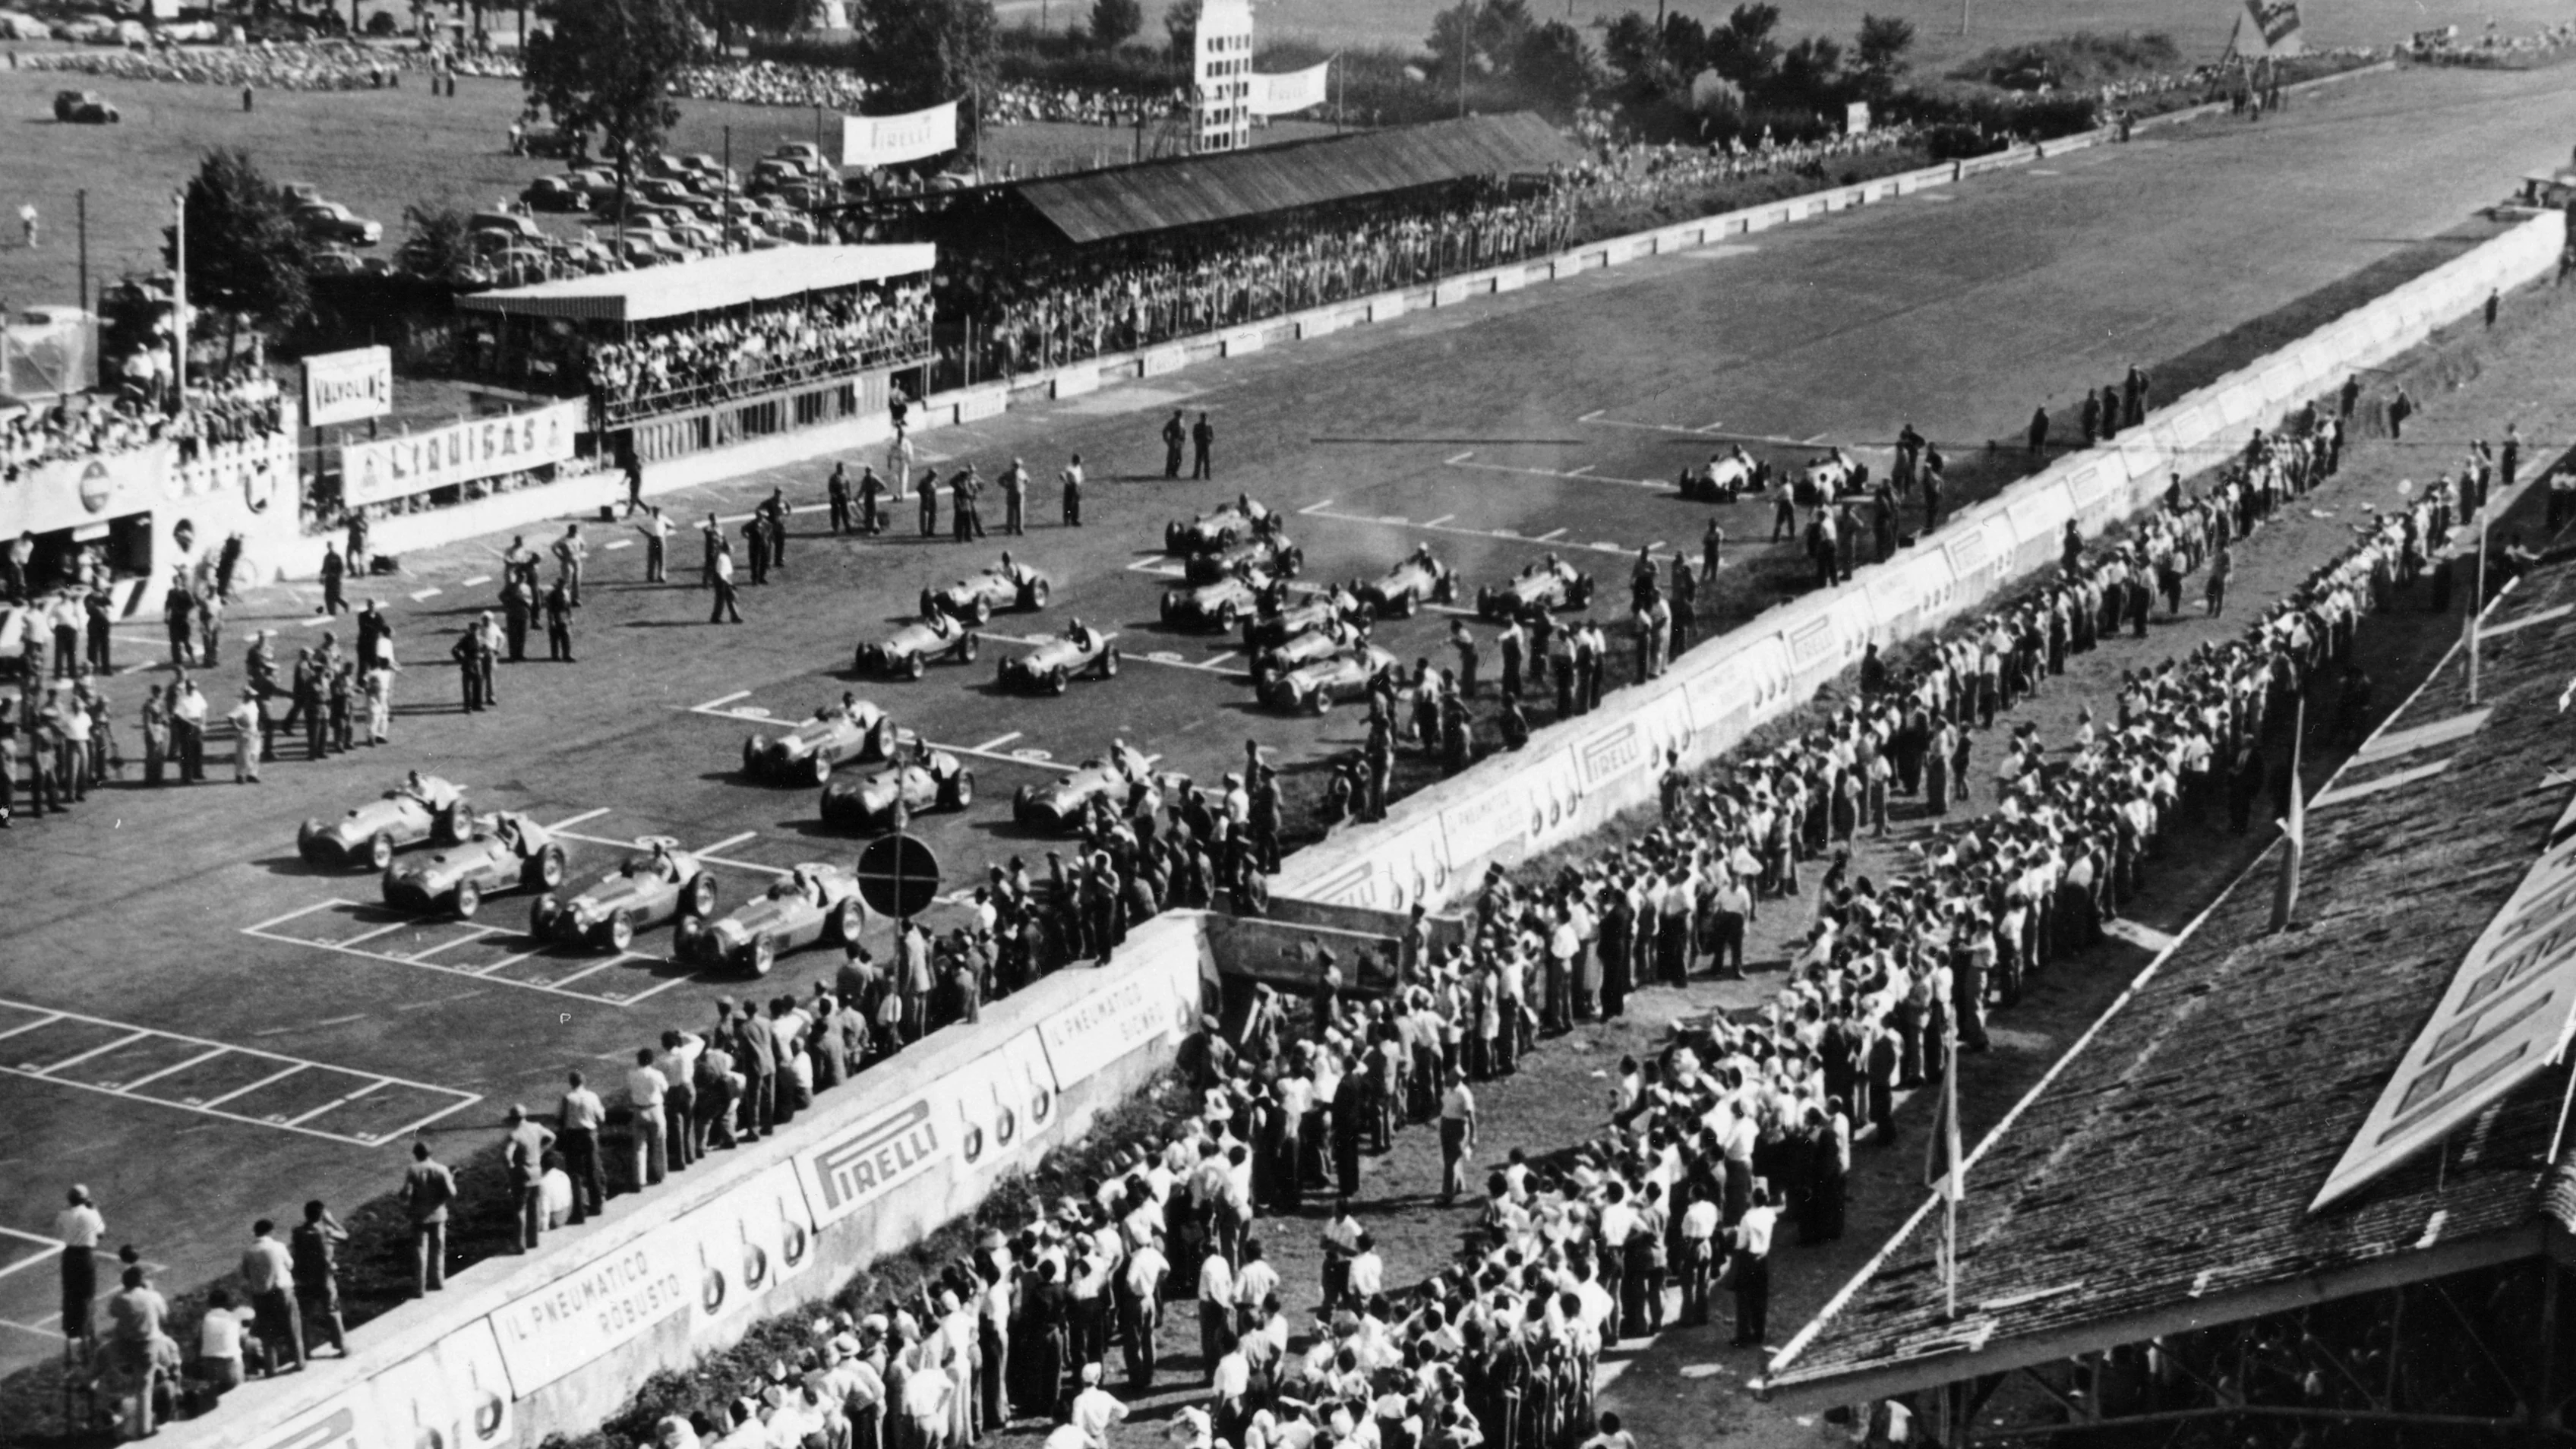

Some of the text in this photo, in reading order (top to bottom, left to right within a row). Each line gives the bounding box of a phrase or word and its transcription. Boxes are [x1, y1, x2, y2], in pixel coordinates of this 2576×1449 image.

[314, 366, 386, 411] VALVOLINE
[391, 418, 535, 479] LIQUIGAS
[1582, 721, 1640, 784] PIRELLI
[1065, 981, 1142, 1038] PNEUMATICO
[813, 1098, 939, 1211] PIRELLI
[506, 1251, 647, 1344] IL PNEUMATICO
[598, 1273, 680, 1334] ROBUSTO
